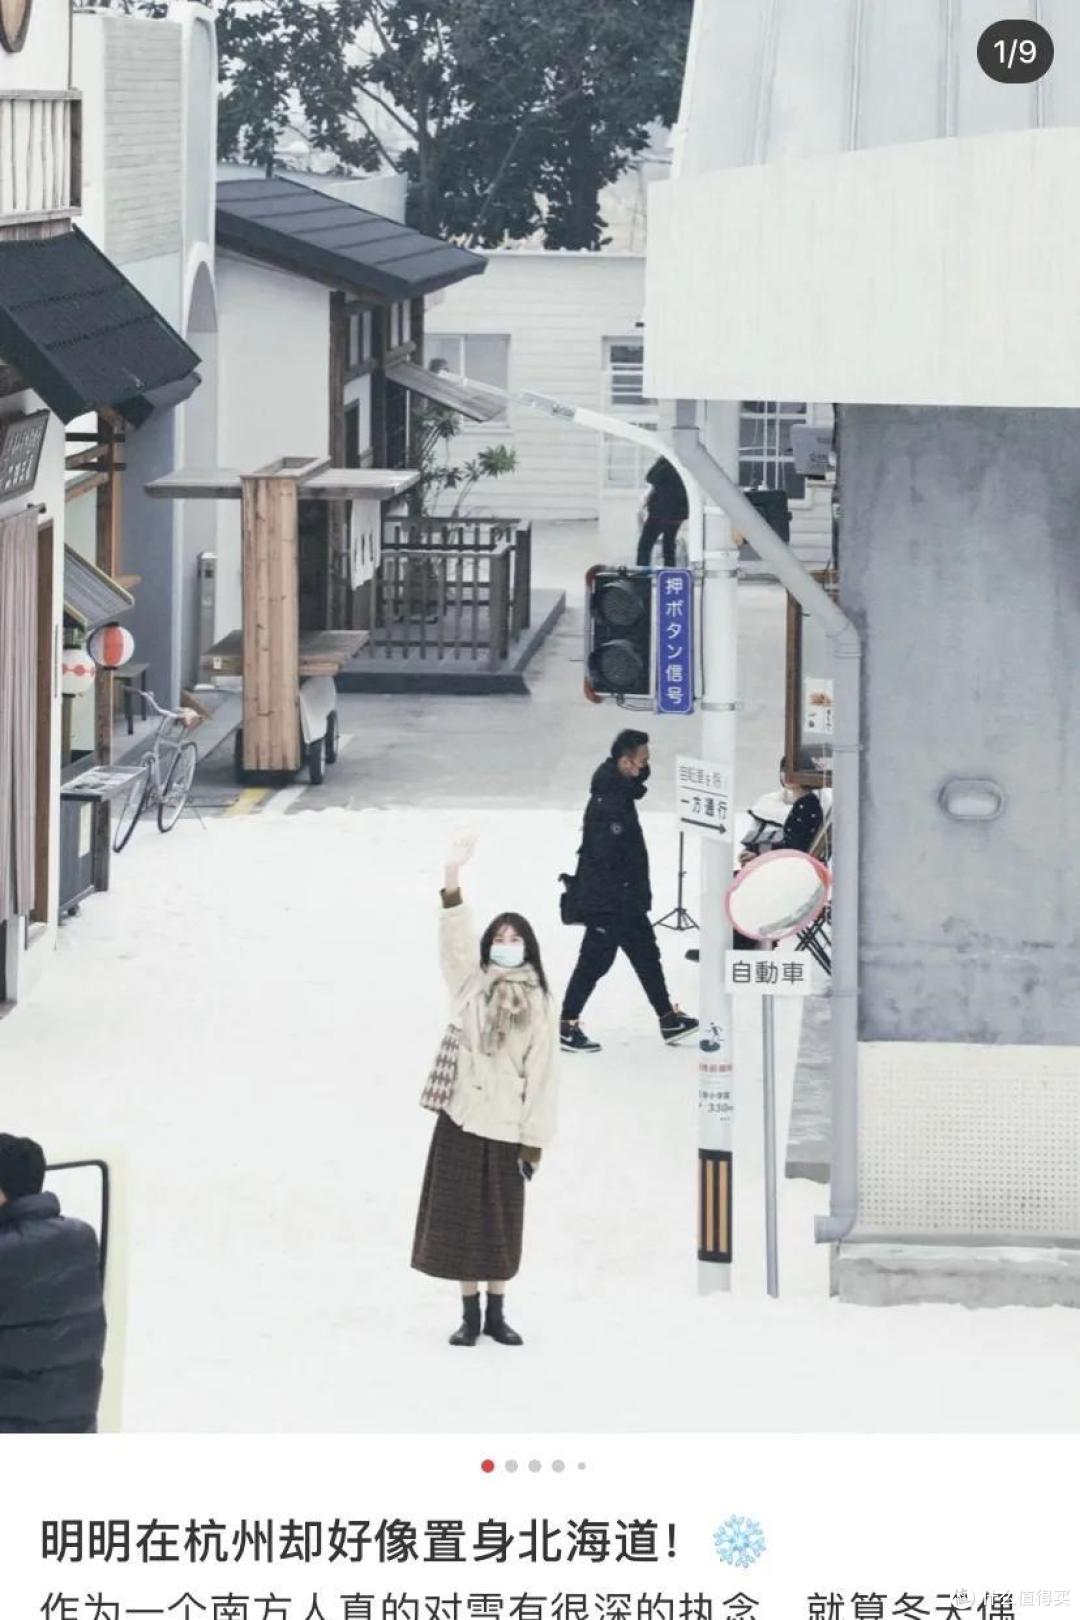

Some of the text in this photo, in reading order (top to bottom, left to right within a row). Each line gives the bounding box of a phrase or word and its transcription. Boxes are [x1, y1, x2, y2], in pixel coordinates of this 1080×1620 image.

[665, 577, 684, 706] 押ボタン信号
[732, 960, 804, 984] 自動車
